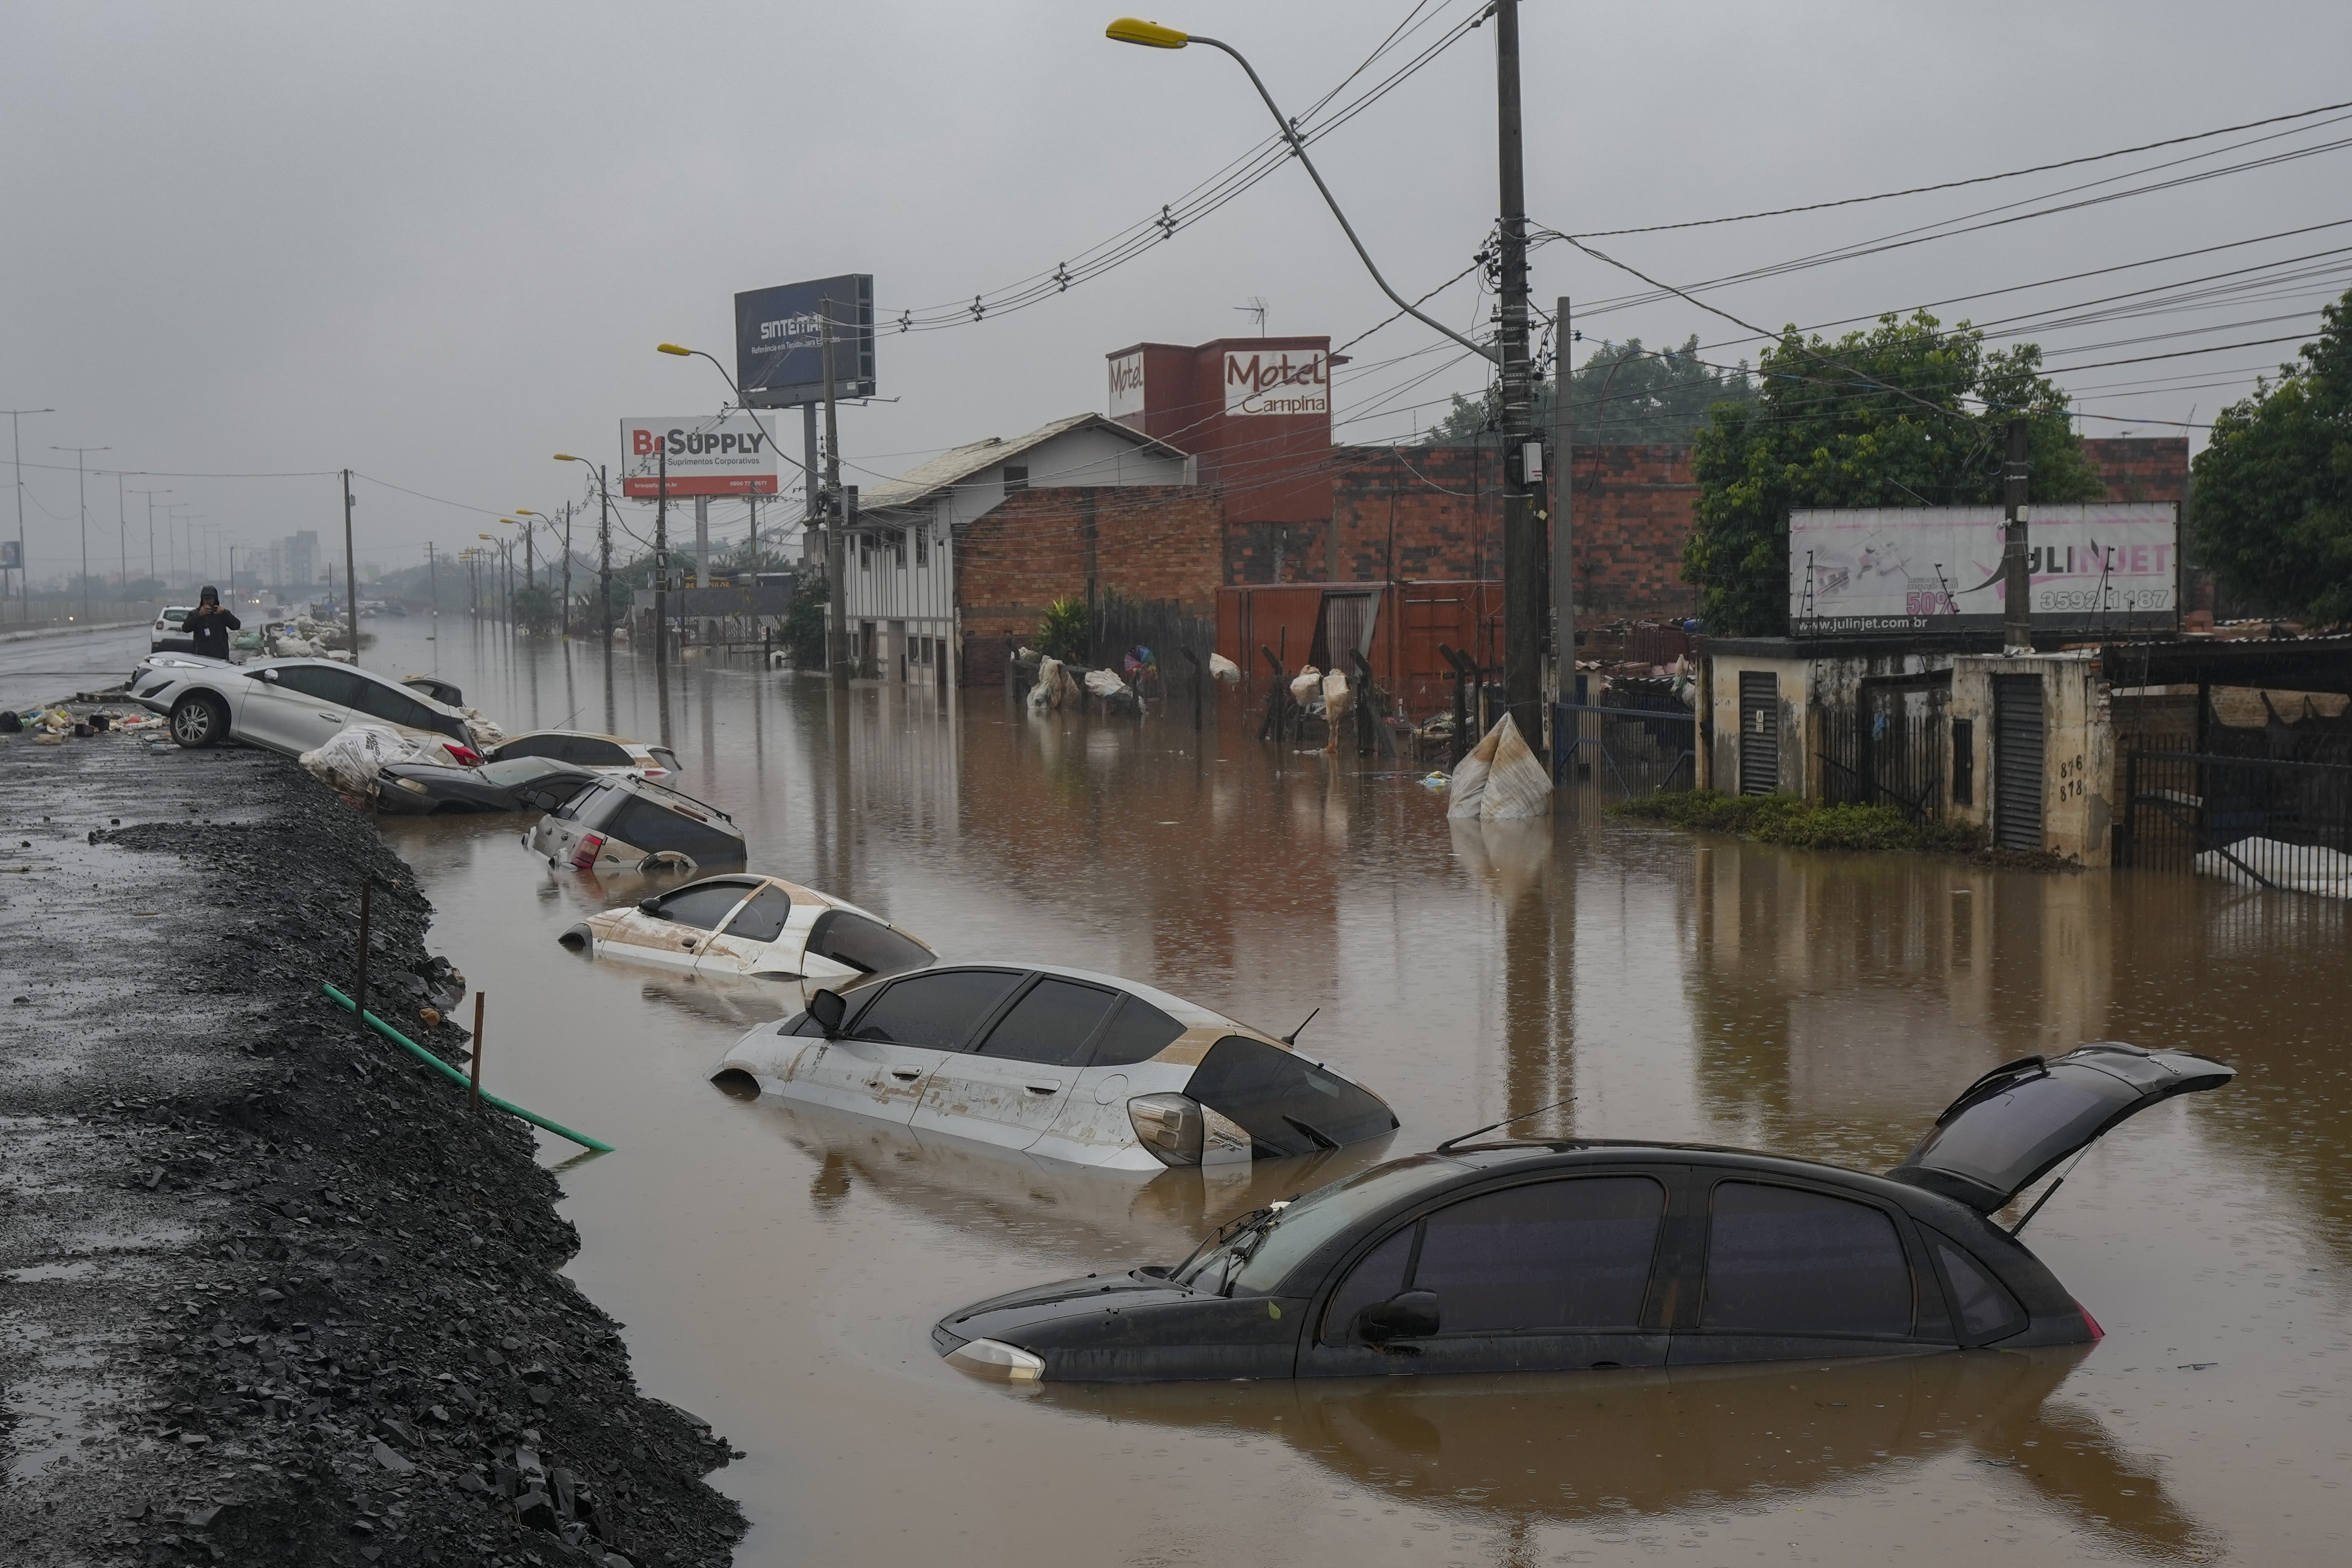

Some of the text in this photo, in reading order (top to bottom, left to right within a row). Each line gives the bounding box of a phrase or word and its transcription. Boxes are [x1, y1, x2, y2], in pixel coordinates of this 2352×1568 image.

[761, 314, 822, 339] SINTEMA
[751, 344, 777, 354] Referência
[1111, 354, 1143, 399] Motel
[1227, 353, 1326, 392] Motel
[1242, 394, 1325, 414] Campina
[715, 457, 760, 466] Corporativos
[1907, 592, 1958, 615] 50%
[2040, 591, 2100, 610] 3592
[2109, 590, 2169, 609] 1187
[2061, 755, 2082, 778] 876
[2061, 779, 2082, 802] 878
[1207, 1136, 1243, 1152] FIT
